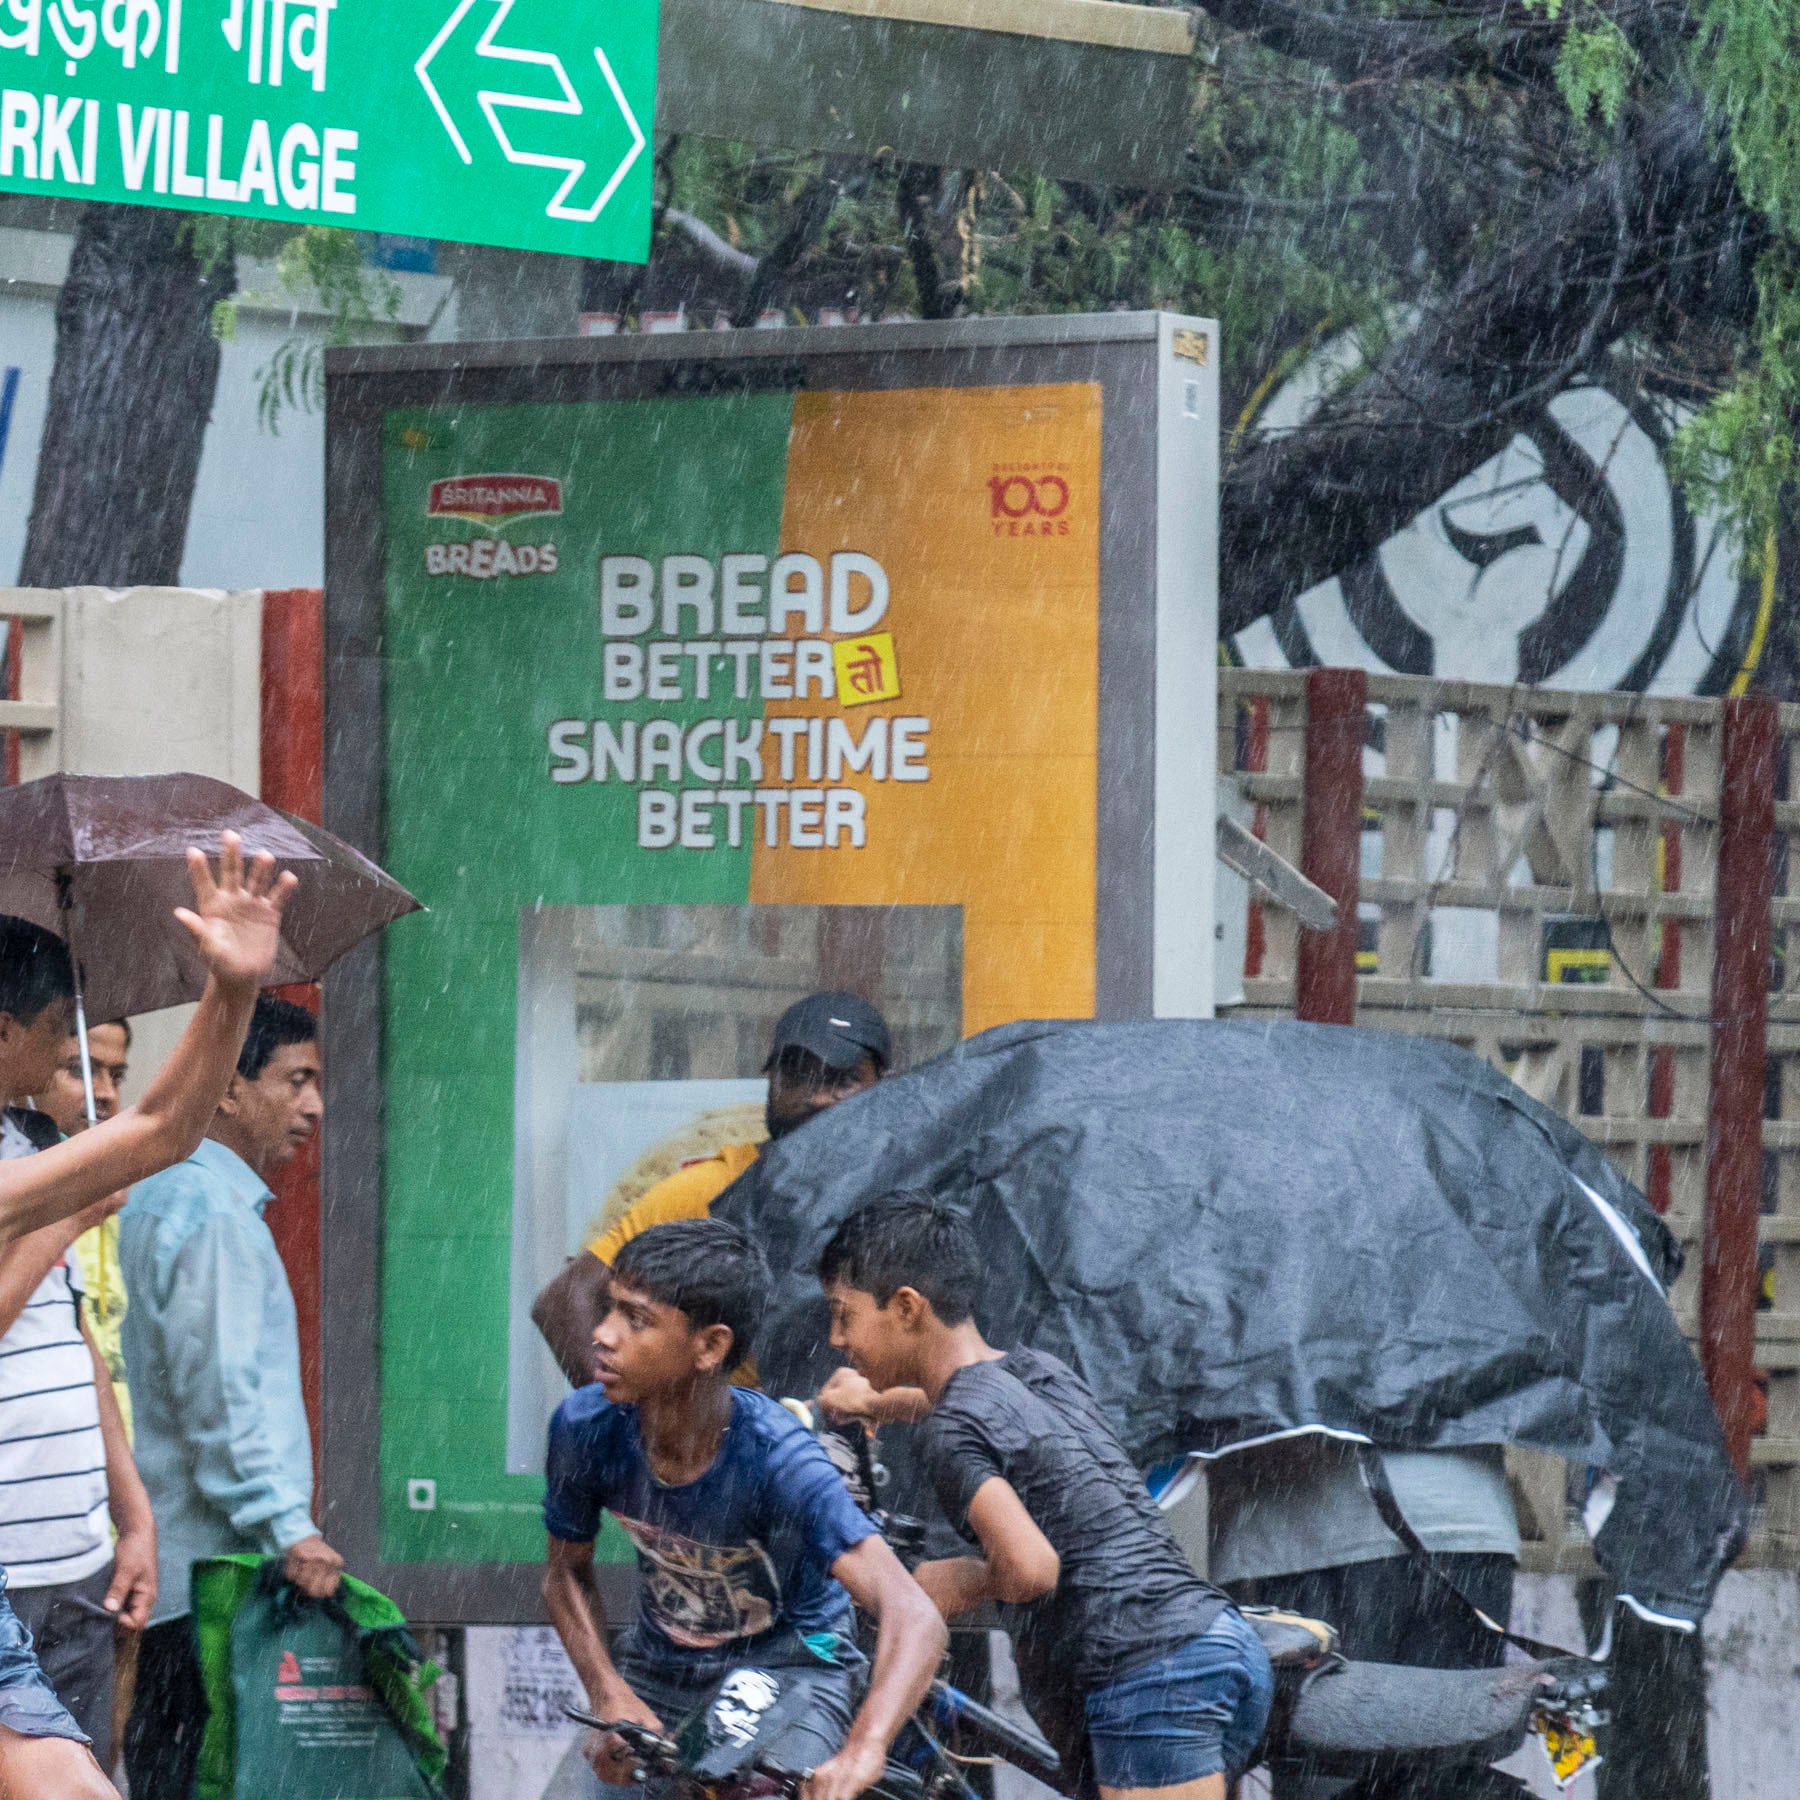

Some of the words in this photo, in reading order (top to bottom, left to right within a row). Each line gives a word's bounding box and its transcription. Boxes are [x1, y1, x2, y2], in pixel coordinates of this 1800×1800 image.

[116, 102, 360, 215] VILLAGE
[441, 486, 547, 505] BRITANNIA
[986, 475, 1070, 518] 100
[992, 520, 1070, 537] YEARS
[426, 539, 558, 579] BREADS
[600, 552, 890, 636] BREAD
[603, 640, 835, 700] BETTER
[847, 645, 883, 694] तो
[548, 717, 931, 783] SNACKTIME
[638, 788, 867, 849] BETTER
